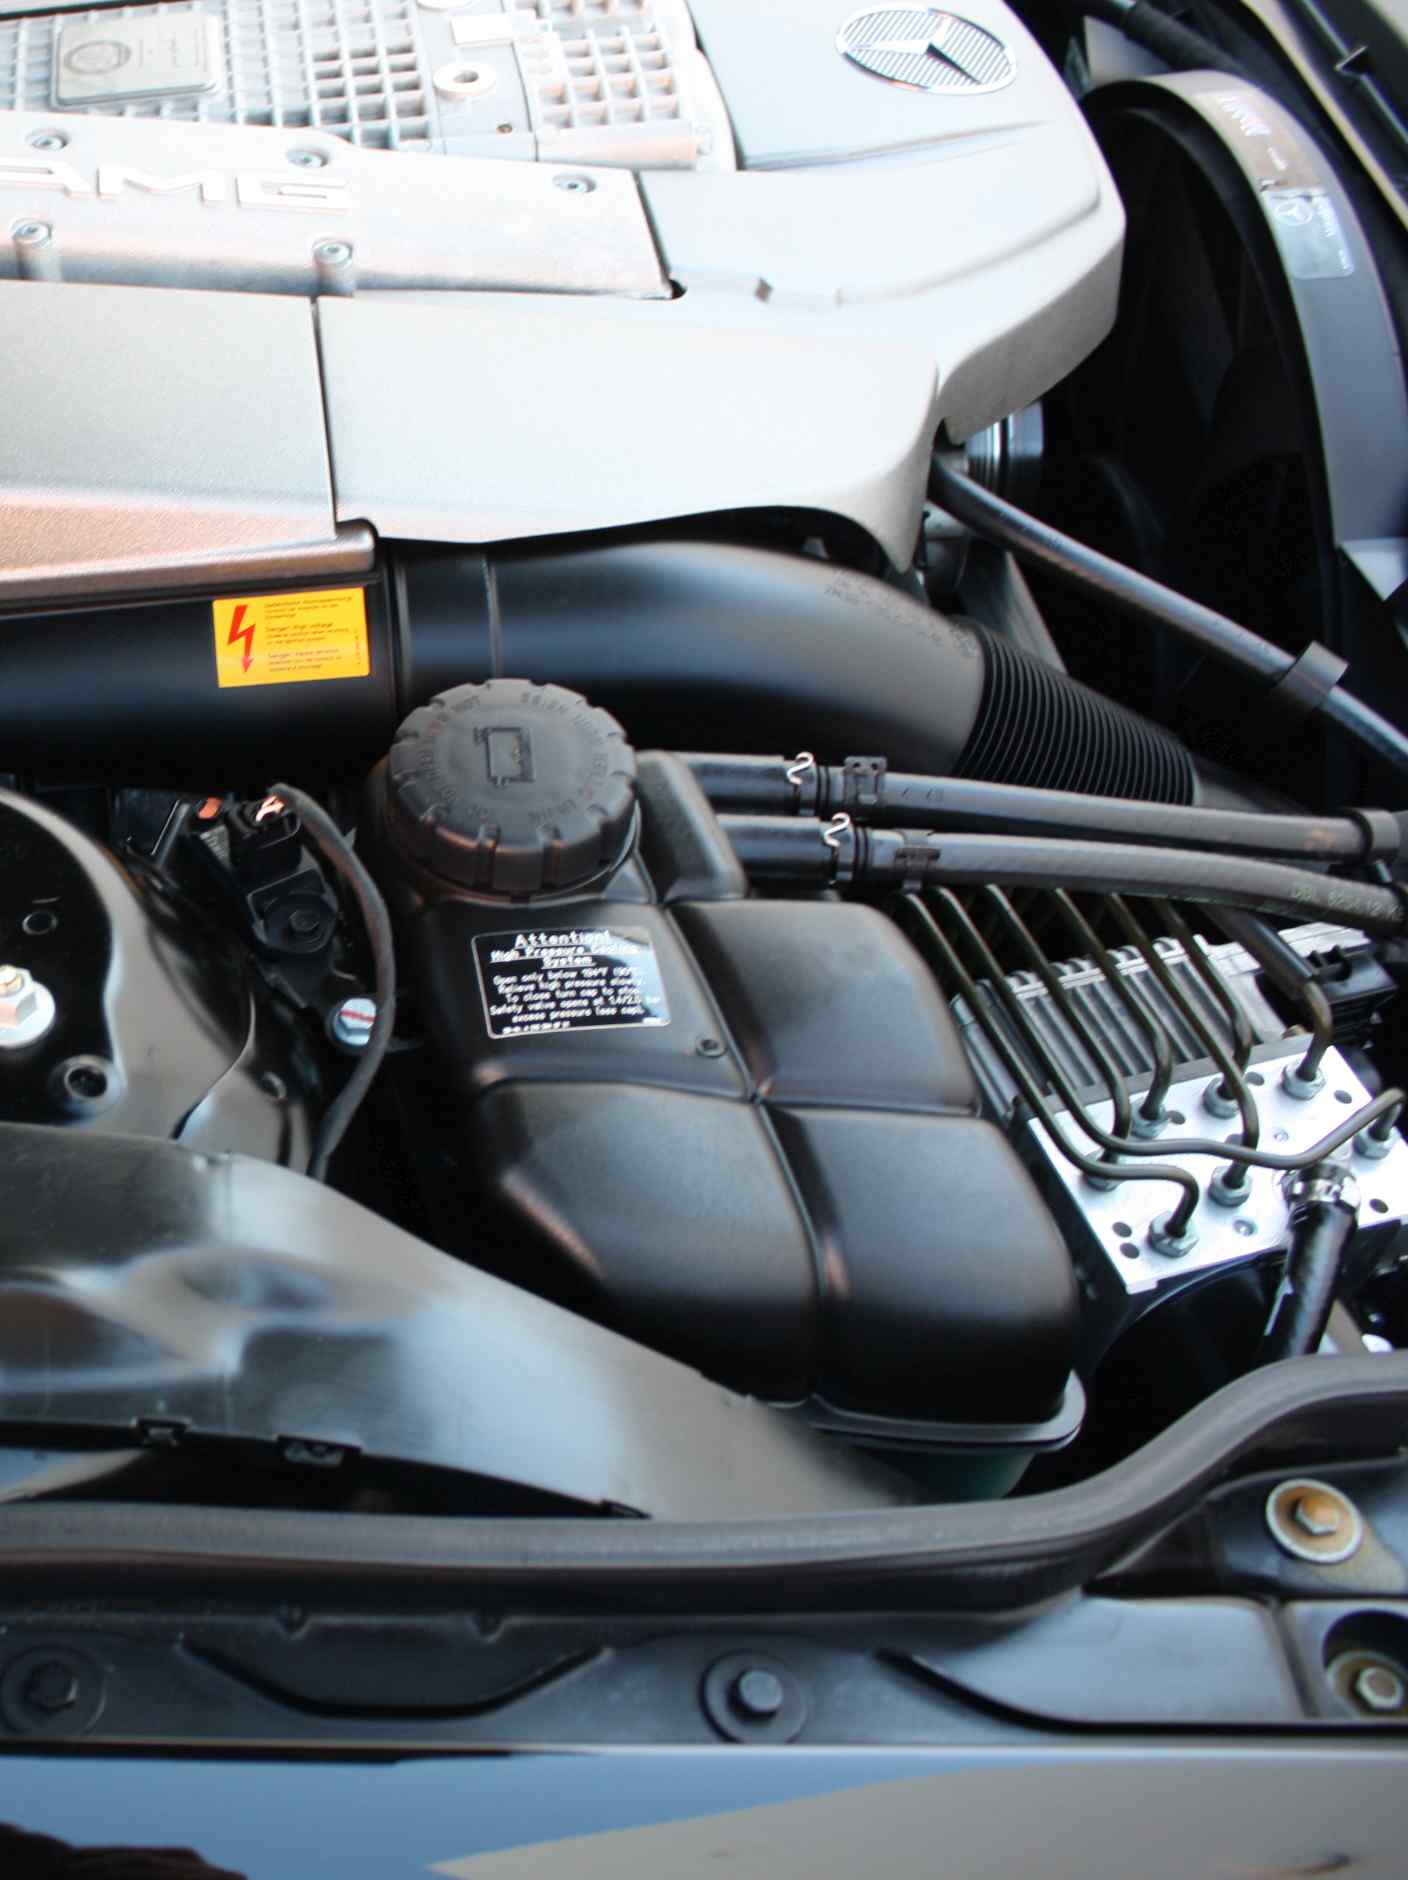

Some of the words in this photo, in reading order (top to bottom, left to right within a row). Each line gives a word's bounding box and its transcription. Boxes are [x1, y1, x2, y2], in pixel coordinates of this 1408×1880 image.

[515, 930, 610, 947] Attention!
[490, 949, 521, 962] High
[524, 945, 585, 958] Pressure
[542, 956, 593, 968] System
